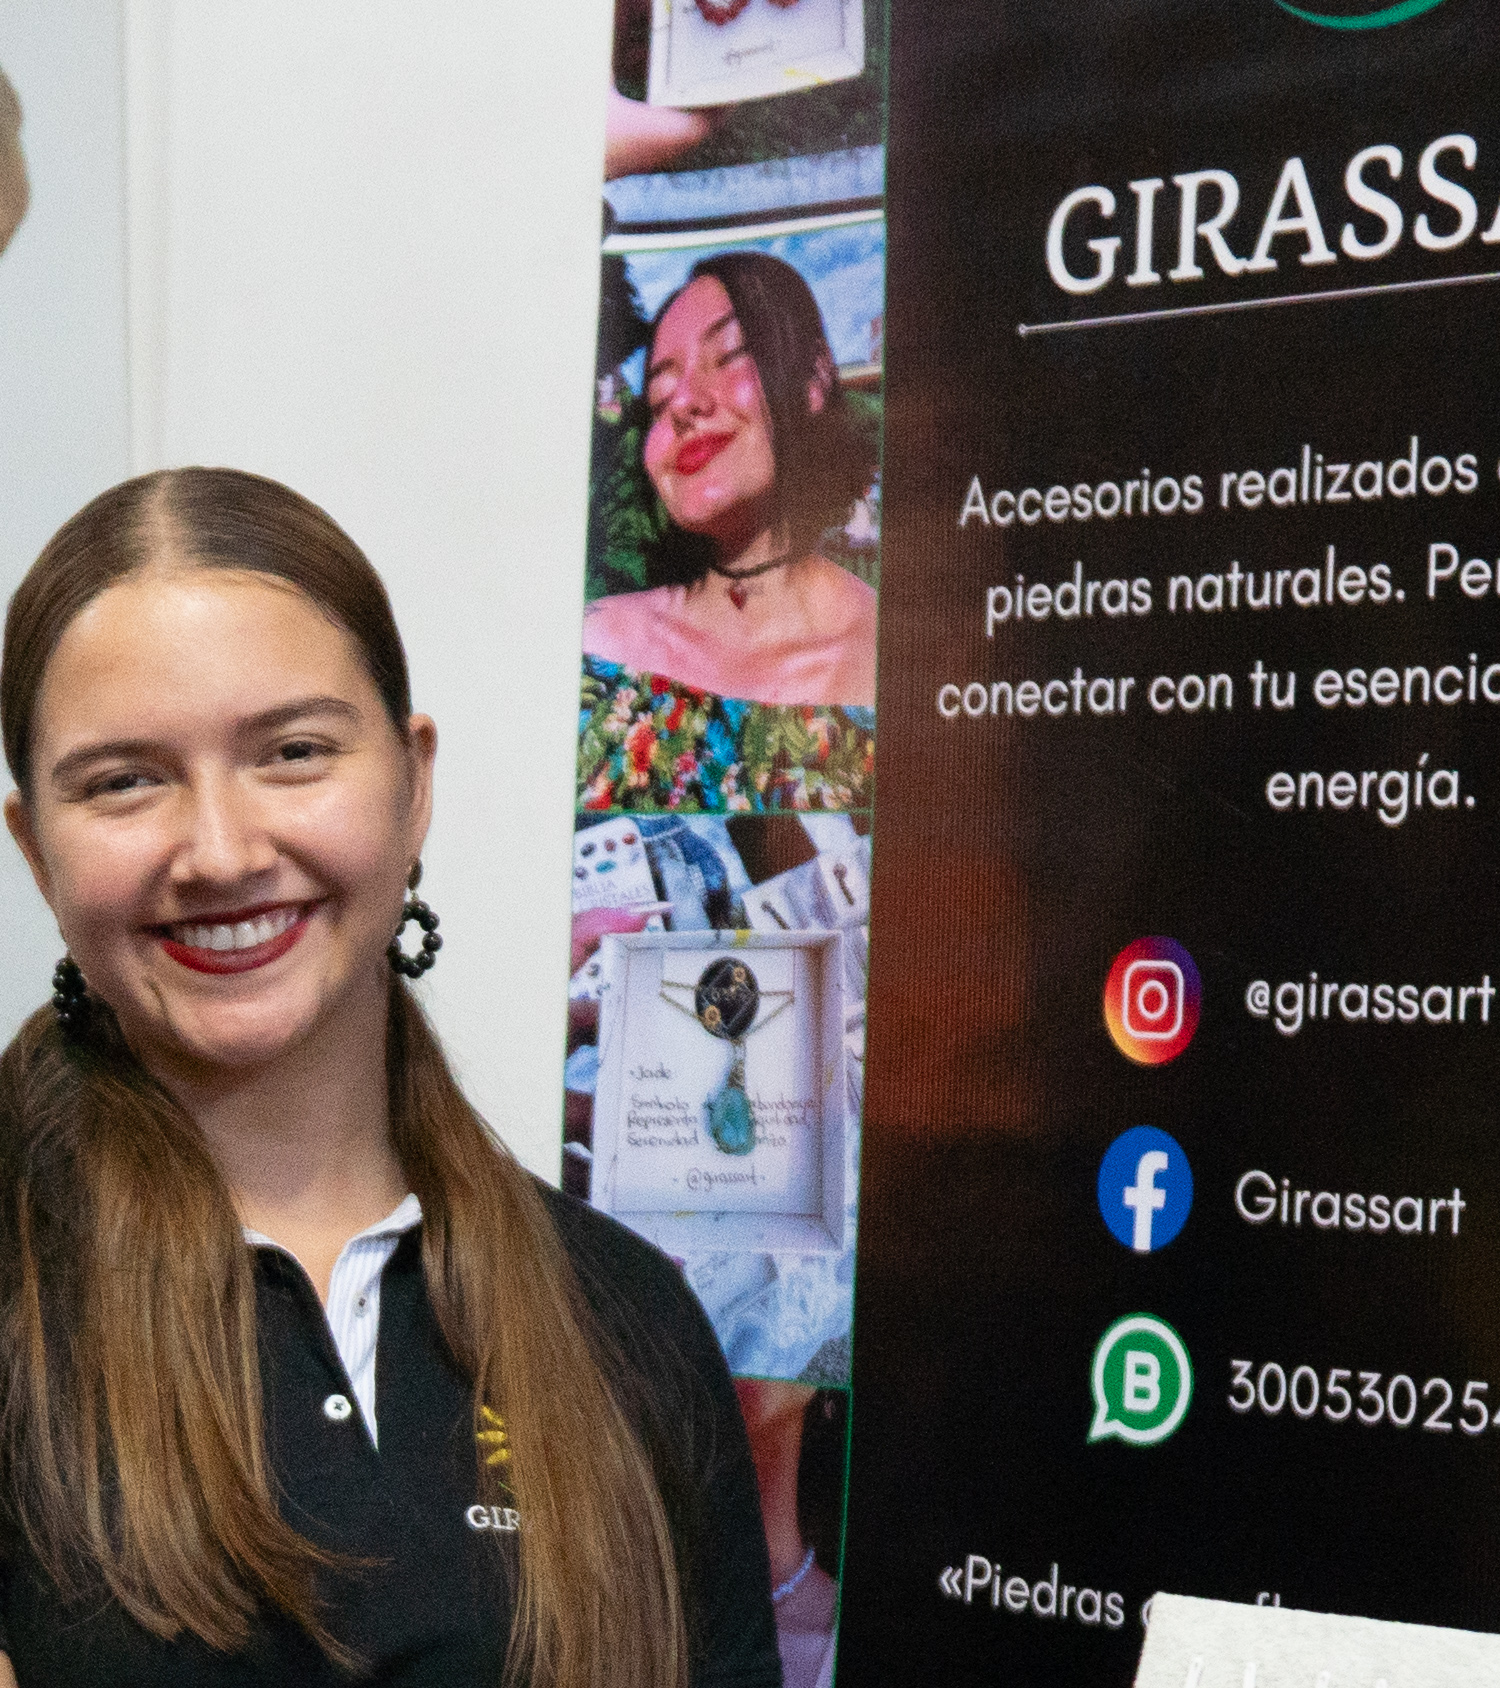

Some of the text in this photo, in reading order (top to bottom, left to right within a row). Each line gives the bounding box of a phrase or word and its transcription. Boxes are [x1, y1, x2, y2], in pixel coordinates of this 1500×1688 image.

[958, 467, 1205, 528] Accesorios
[1220, 445, 1479, 508] realizados
[985, 560, 1153, 638] piedras
[1168, 544, 1406, 612] naturales.
[935, 667, 1136, 721] conectar
[1148, 672, 1234, 713] con
[1249, 660, 1297, 709] tu
[1265, 752, 1476, 827] energía.
[1245, 971, 1497, 1035] @girassart
[1234, 1169, 1467, 1235] Girassart
[938, 1553, 1126, 1628] «Piedras
